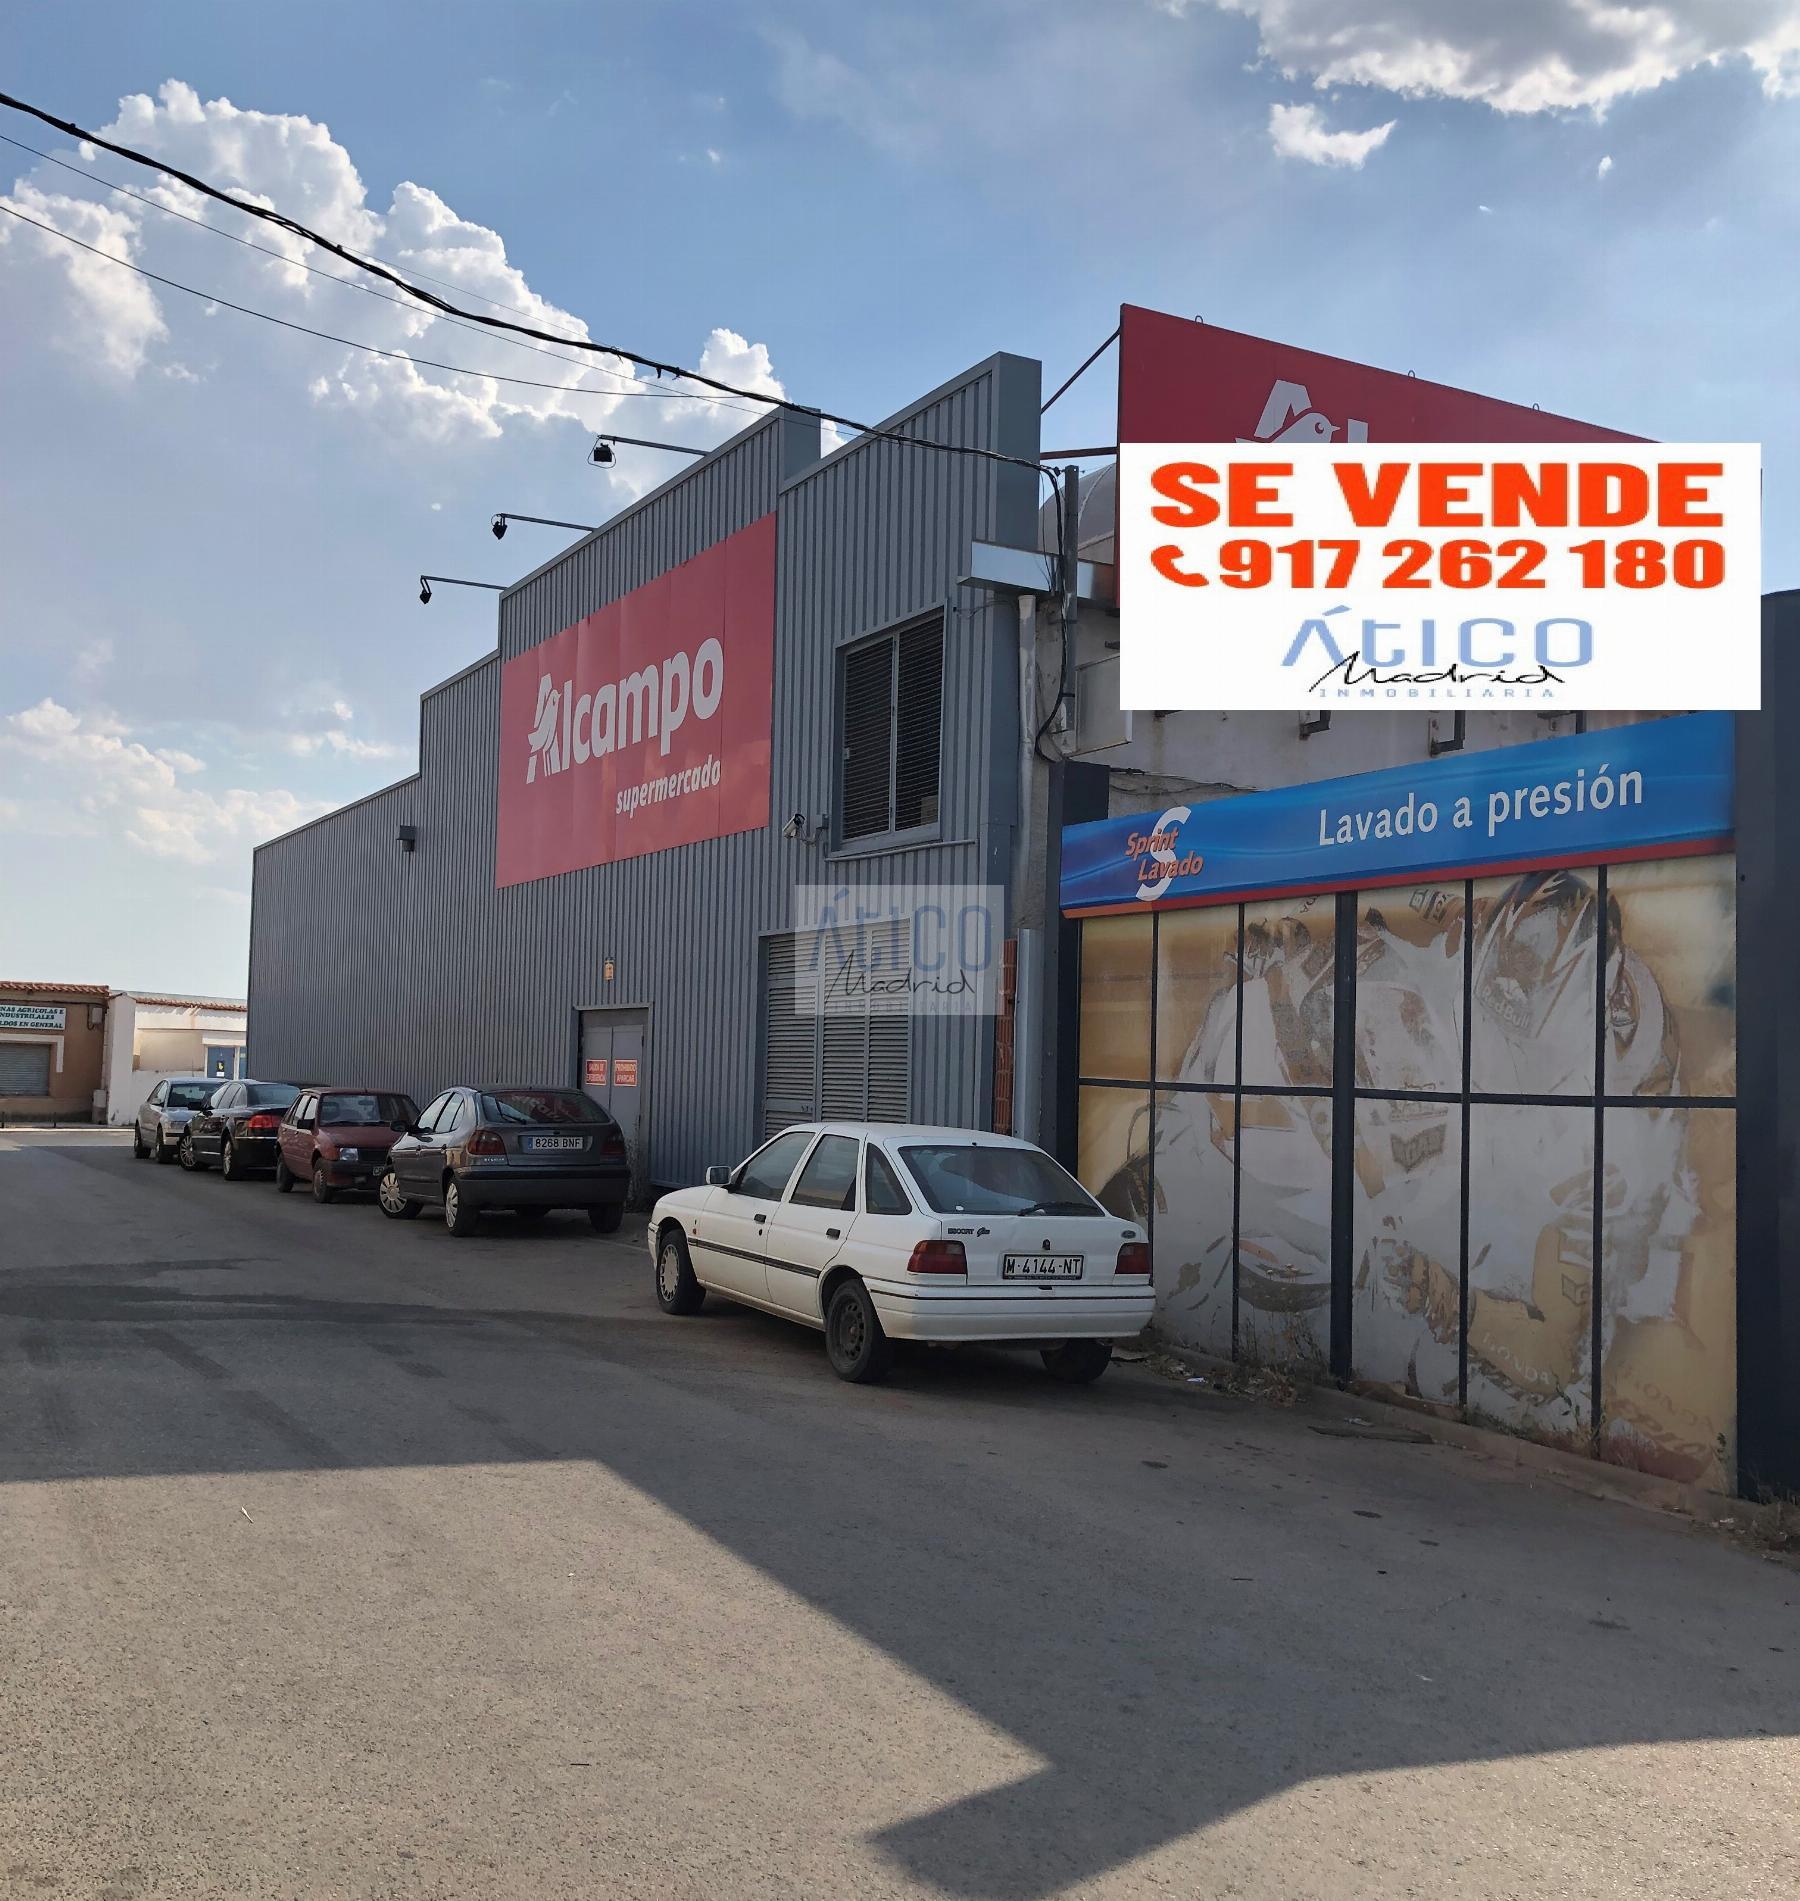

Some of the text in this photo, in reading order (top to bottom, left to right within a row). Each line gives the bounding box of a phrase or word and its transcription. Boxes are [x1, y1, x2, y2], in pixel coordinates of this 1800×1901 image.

[526, 637, 724, 785] Alcampo
[616, 753, 722, 820] supermercado
[1319, 763, 1643, 846] Lavado a presión
[1125, 826, 1180, 861] Sprint
[1138, 850, 1204, 881] Lavado
[535, 1138, 581, 1149] 8268 BNF
